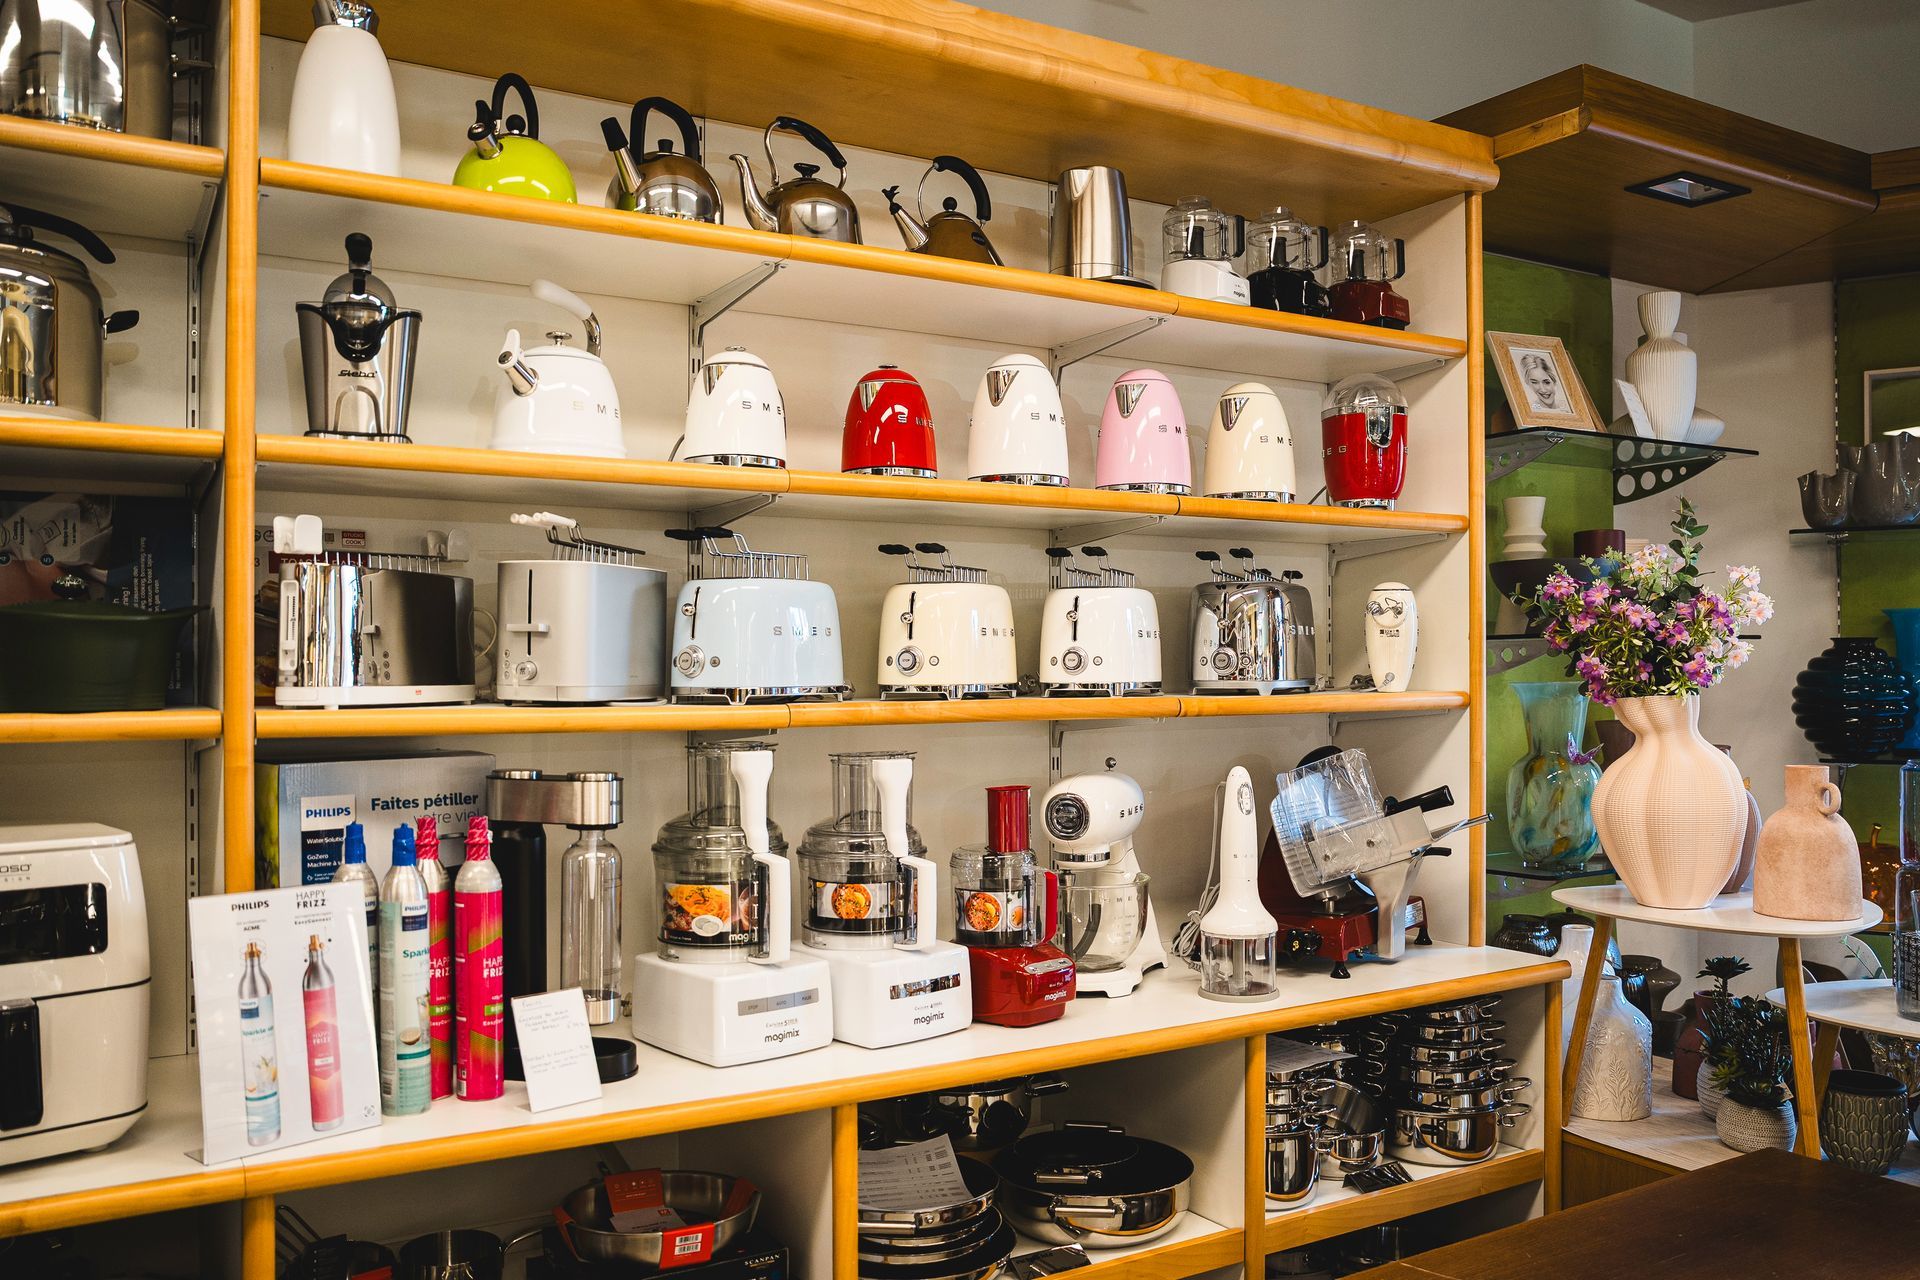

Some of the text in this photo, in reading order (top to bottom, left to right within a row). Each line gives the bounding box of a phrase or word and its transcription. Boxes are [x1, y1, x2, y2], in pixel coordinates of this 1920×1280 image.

[338, 369, 376, 378] Steba
[573, 400, 619, 418] SME
[742, 400, 782, 415] SME
[897, 414, 934, 429] SME
[1031, 412, 1065, 427] SME
[1260, 435, 1293, 447] SME
[773, 625, 833, 637] SMEG
[371, 792, 479, 811] Faites pétiller
[305, 806, 351, 818] PHILIPS
[306, 837, 323, 845] Water
[296, 889, 326, 901] HAPPY
[231, 899, 270, 912] PHILIPS
[296, 899, 327, 910] FRIZZ
[429, 966, 451, 978] FRIZ
[483, 966, 503, 979] FRIZ
[1044, 989, 1067, 1001] magimix
[913, 1011, 945, 1026] magimix
[764, 1028, 800, 1043] magimix
[744, 1253, 781, 1266] SCANPAN
